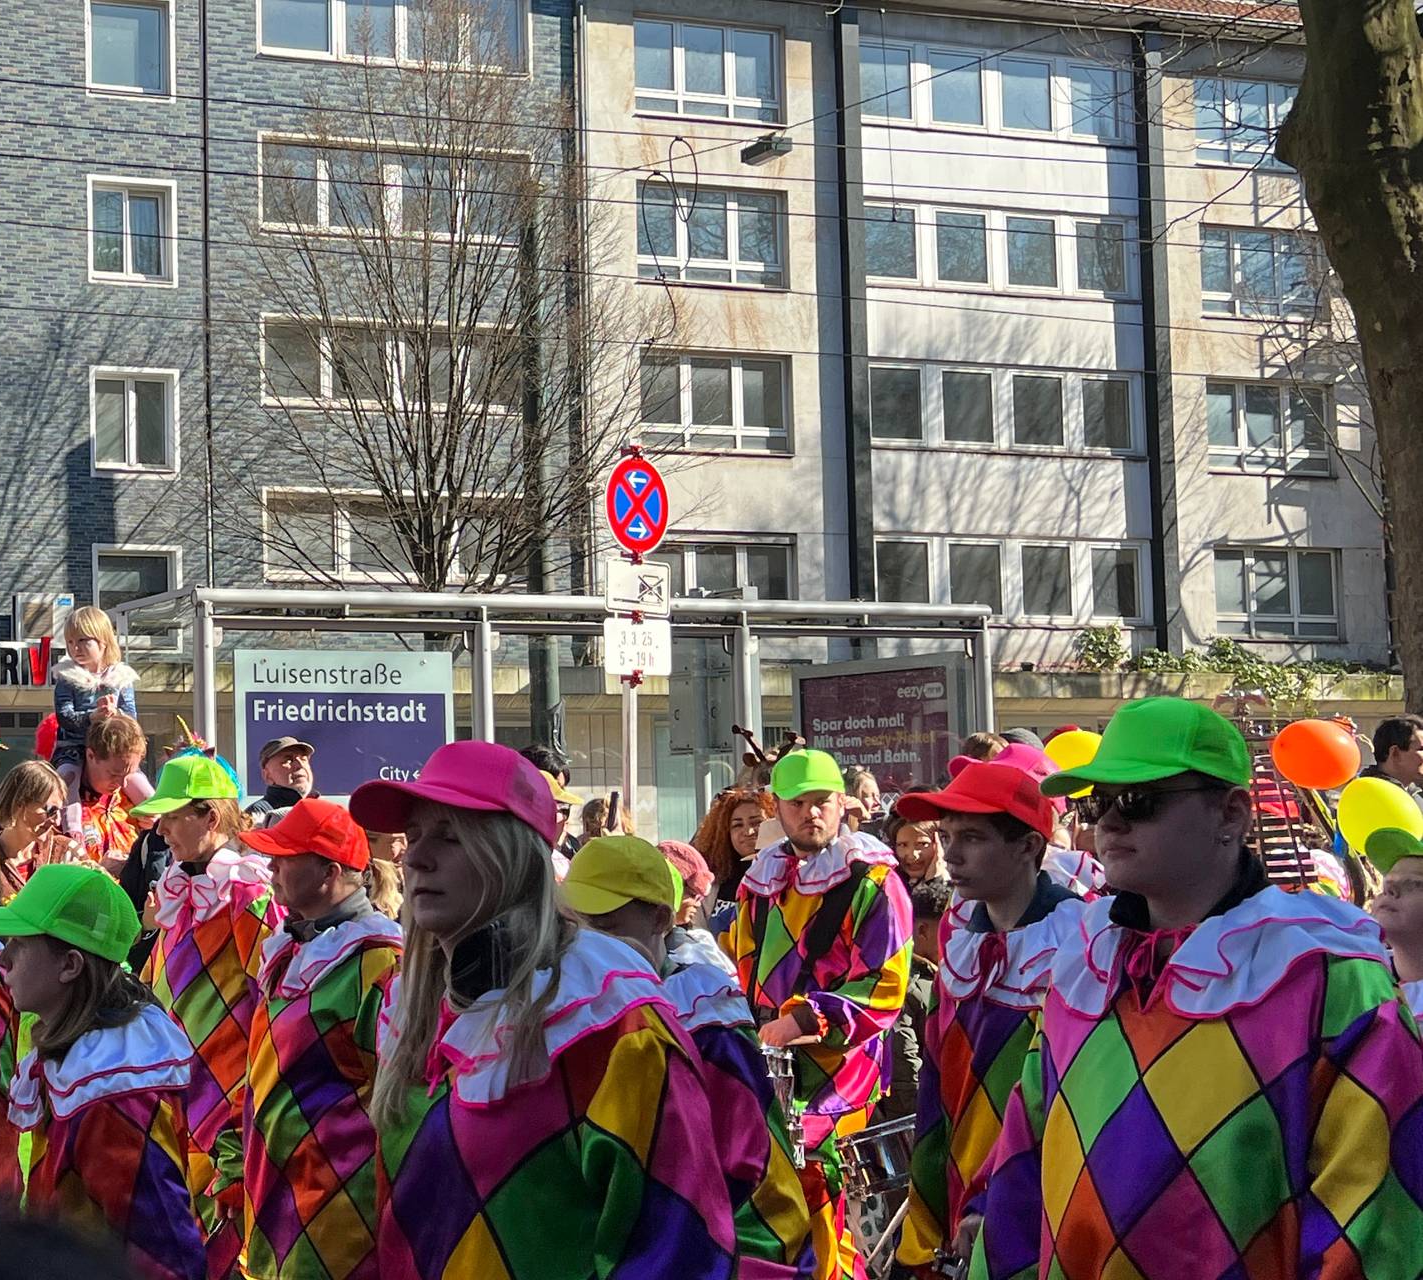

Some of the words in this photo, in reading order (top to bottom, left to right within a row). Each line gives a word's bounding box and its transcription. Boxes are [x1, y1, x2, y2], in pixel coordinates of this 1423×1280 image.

[253, 662, 402, 685] Luisenstraße
[253, 698, 427, 722] Friedrichstadt
[812, 718, 843, 734] Spar
[844, 715, 875, 730] doch
[877, 712, 905, 728] mal!
[813, 734, 834, 748] Mit
[836, 734, 862, 747] dem
[834, 751, 857, 765] Bus
[859, 749, 882, 764] und
[884, 749, 922, 763] Bahn.
[379, 766, 410, 783] City
